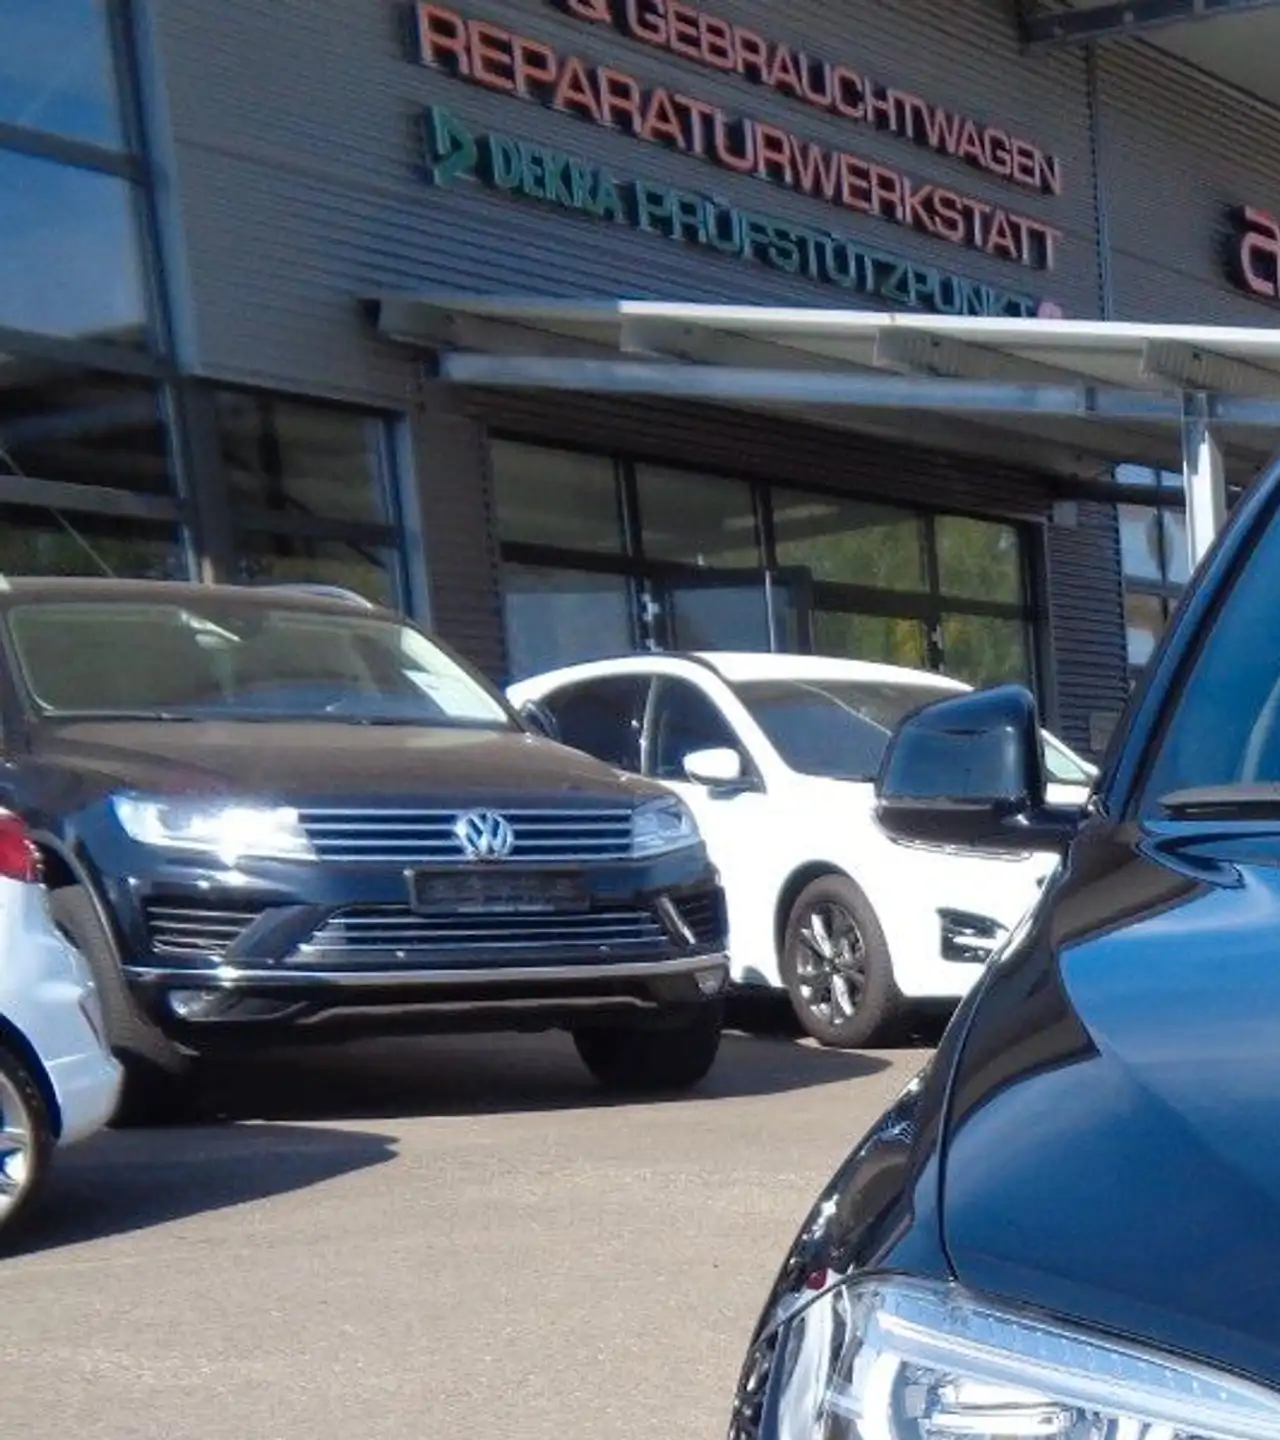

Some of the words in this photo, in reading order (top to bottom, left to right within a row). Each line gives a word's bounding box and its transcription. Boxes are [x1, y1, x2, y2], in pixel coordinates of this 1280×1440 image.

[418, 3, 1064, 270] REPARATURWERKSTATT
[489, 134, 625, 224] DEKRA
[626, 0, 1060, 196] GEBRAUCHTWAGEN
